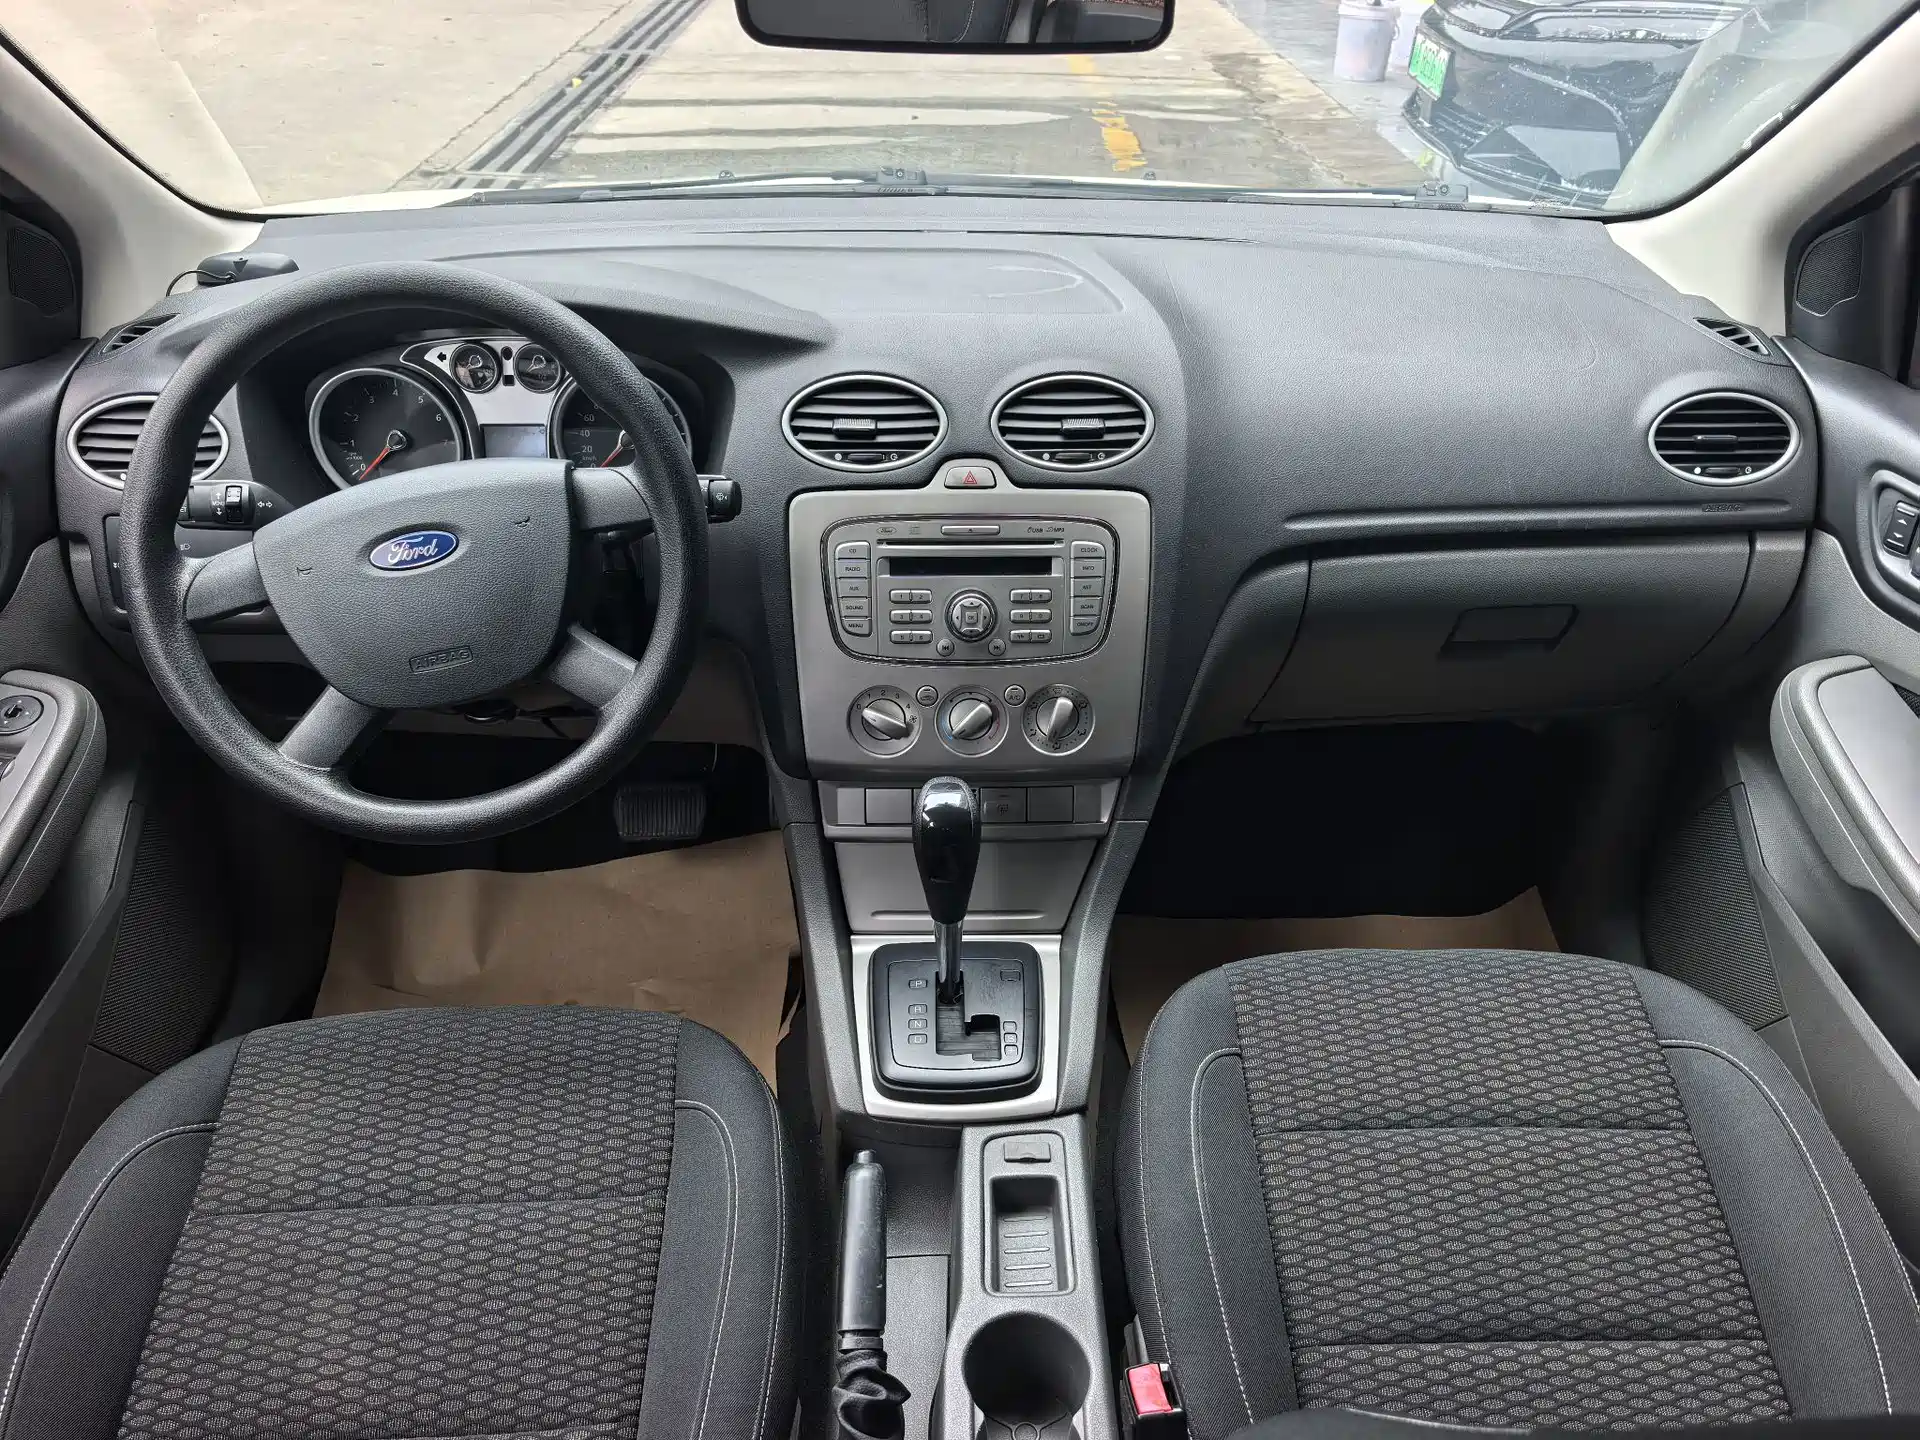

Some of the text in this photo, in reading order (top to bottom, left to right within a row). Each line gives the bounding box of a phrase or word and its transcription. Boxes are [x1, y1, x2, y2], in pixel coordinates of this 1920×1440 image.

[392, 389, 399, 397] 4
[418, 396, 424, 404] 5
[353, 414, 359, 422] 2
[584, 414, 595, 422] 60
[580, 429, 591, 437] 40
[581, 445, 593, 453] 20
[361, 463, 366, 471] 0
[387, 536, 438, 565] Ford
[415, 649, 471, 669] AIRBAG
[914, 1035, 922, 1043] D
